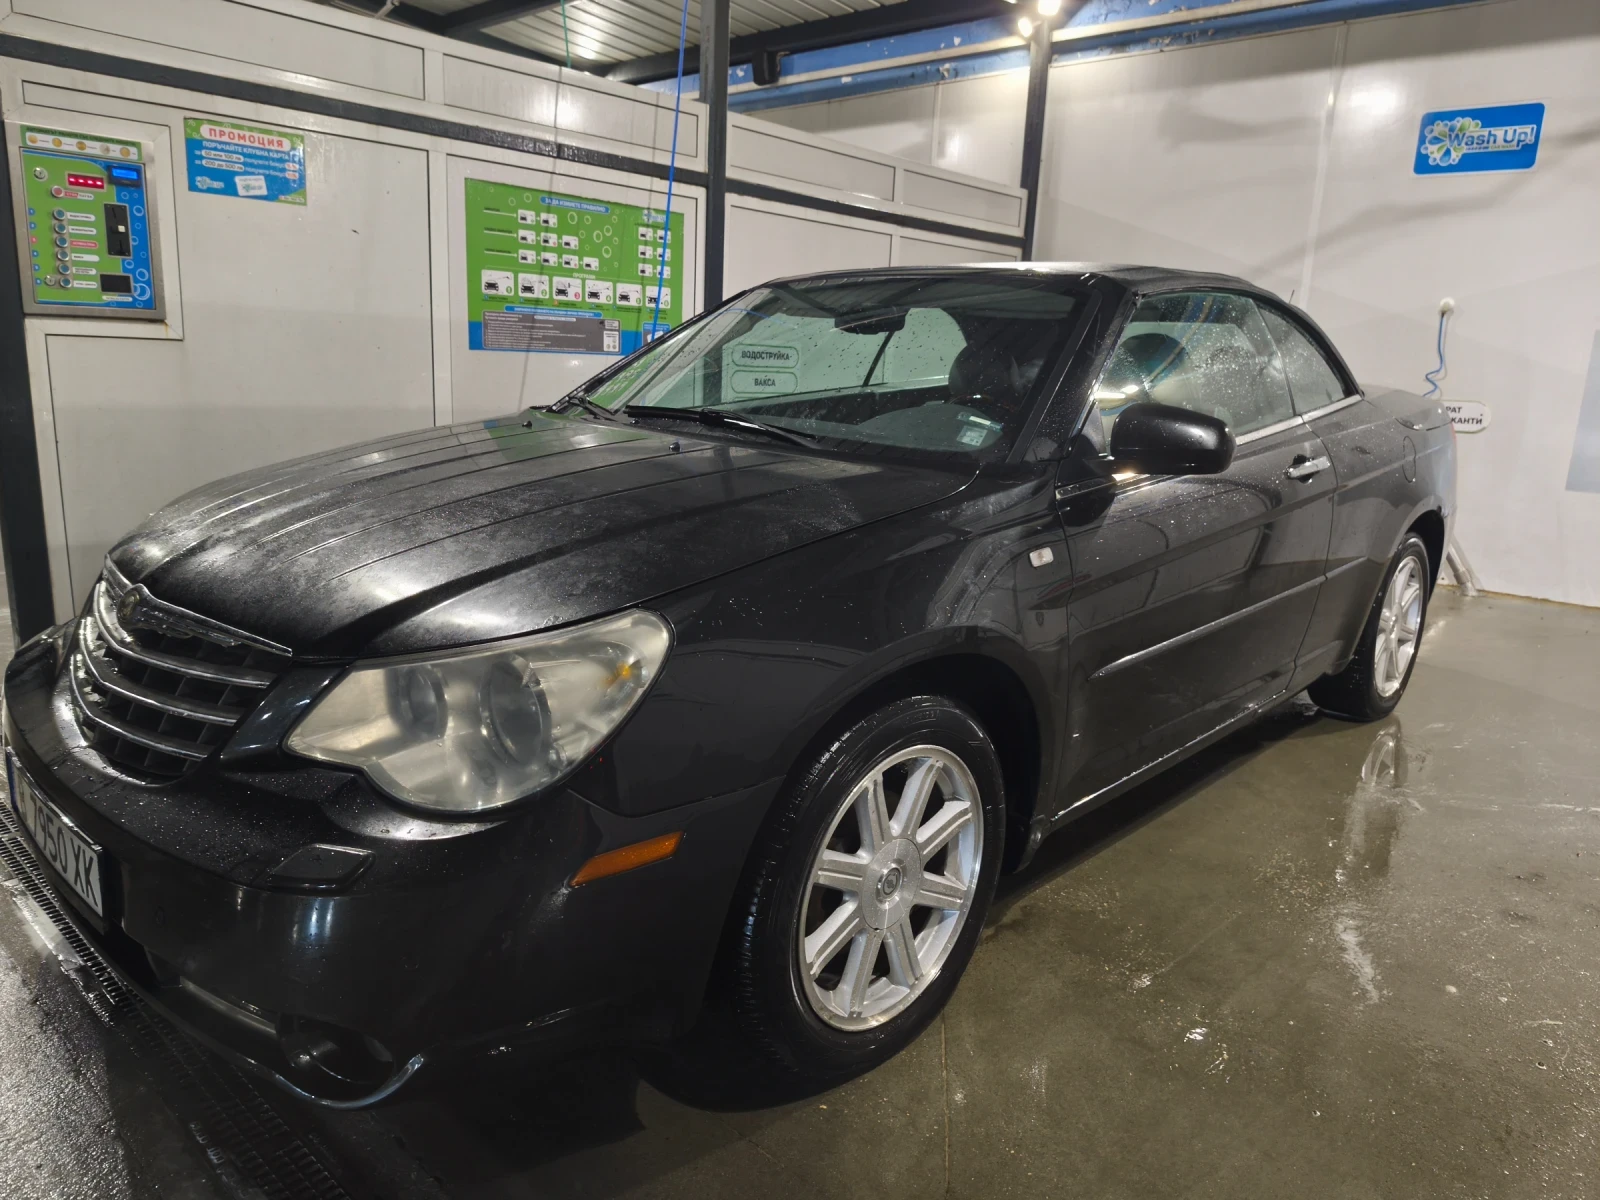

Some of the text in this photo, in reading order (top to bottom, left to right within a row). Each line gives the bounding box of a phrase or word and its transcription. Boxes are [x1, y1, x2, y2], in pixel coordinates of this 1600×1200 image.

[208, 127, 284, 149] ПРОМОЦИЯ
[1448, 126, 1535, 148] Wash Up!
[202, 140, 290, 161] ПОРЪЧАЙТЕ КЛУБНА КАРТА
[741, 350, 790, 361] ВОДОСТРУЙКА
[754, 378, 776, 387] ВАКСА
[30, 792, 68, 875] 7950
[70, 837, 99, 908] XK
